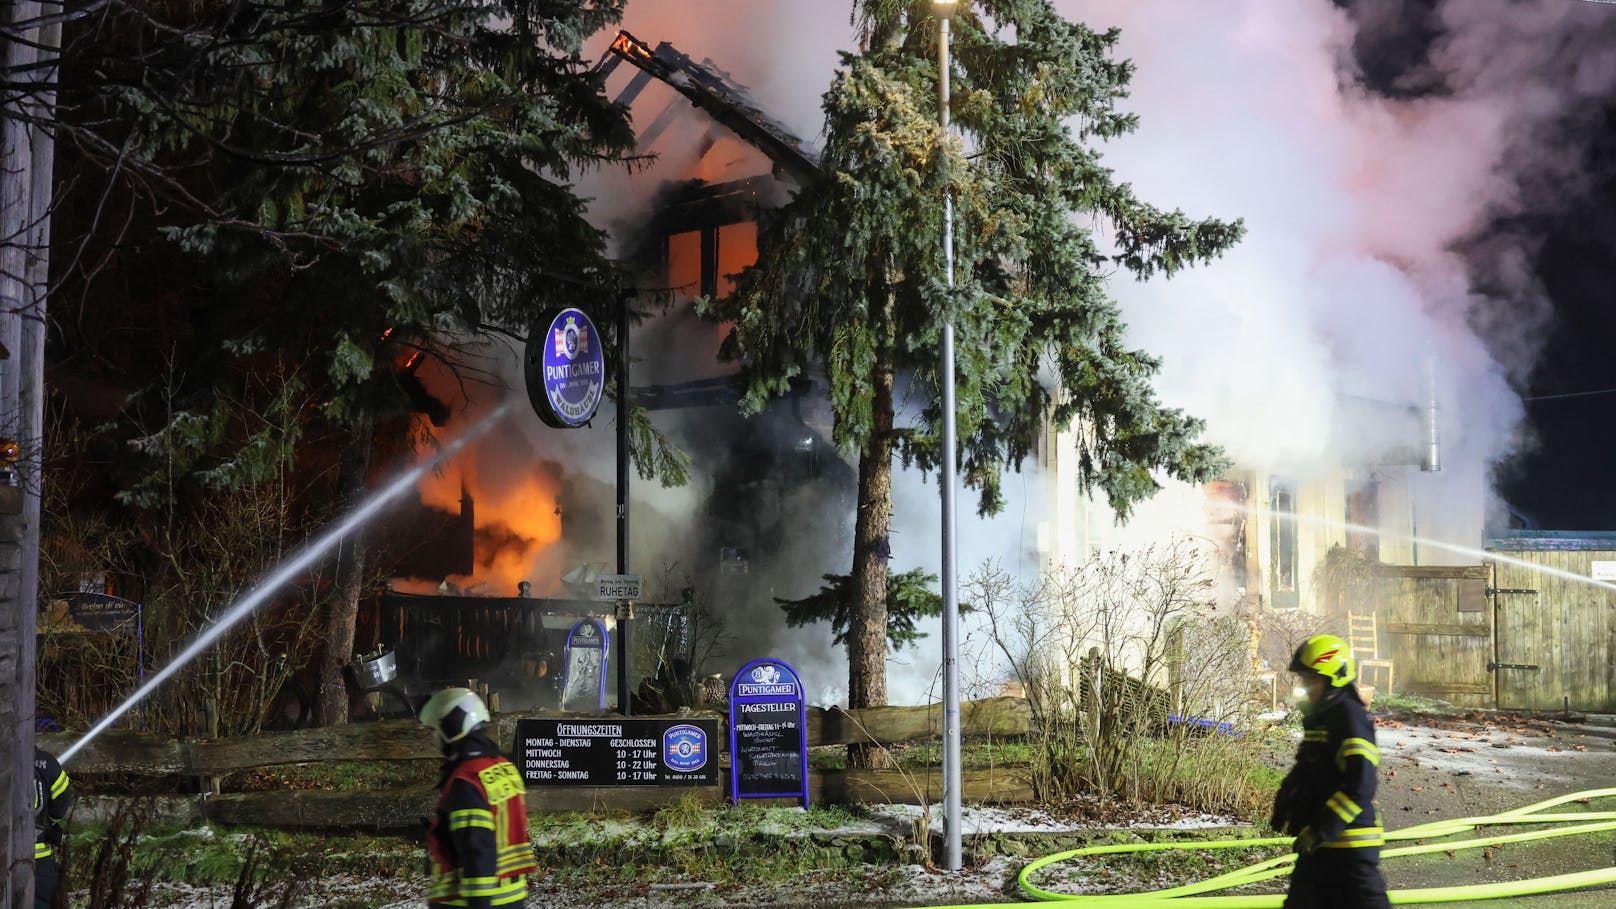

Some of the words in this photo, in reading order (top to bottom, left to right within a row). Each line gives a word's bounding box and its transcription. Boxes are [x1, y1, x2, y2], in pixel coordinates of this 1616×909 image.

[547, 361, 600, 381] PUNTIGAMER
[600, 586, 639, 597] RUHETAG
[742, 685, 792, 694] PUNTIGAMER
[740, 703, 796, 713] TAGESTELLER
[557, 723, 622, 735] ÖFFNUNGSZEITEN
[668, 729, 703, 740] PUNTIGAMER
[526, 738, 554, 747] MONTAG
[560, 738, 592, 747] DIENSTAG
[610, 739, 657, 748] GESCHLOSSEN
[526, 749, 562, 758] MITTWOCH
[616, 750, 626, 758] 10
[632, 750, 641, 758] 17
[643, 750, 657, 759] Uhr
[526, 760, 570, 769] DONNERSTAG
[616, 761, 626, 769] 10
[632, 761, 641, 769] 22
[643, 761, 657, 769] Uhr
[526, 770, 552, 779] FREITAG
[558, 771, 589, 779] SONNTAG
[617, 772, 626, 780] 10
[632, 772, 641, 780] 17
[643, 772, 657, 780] Uhr
